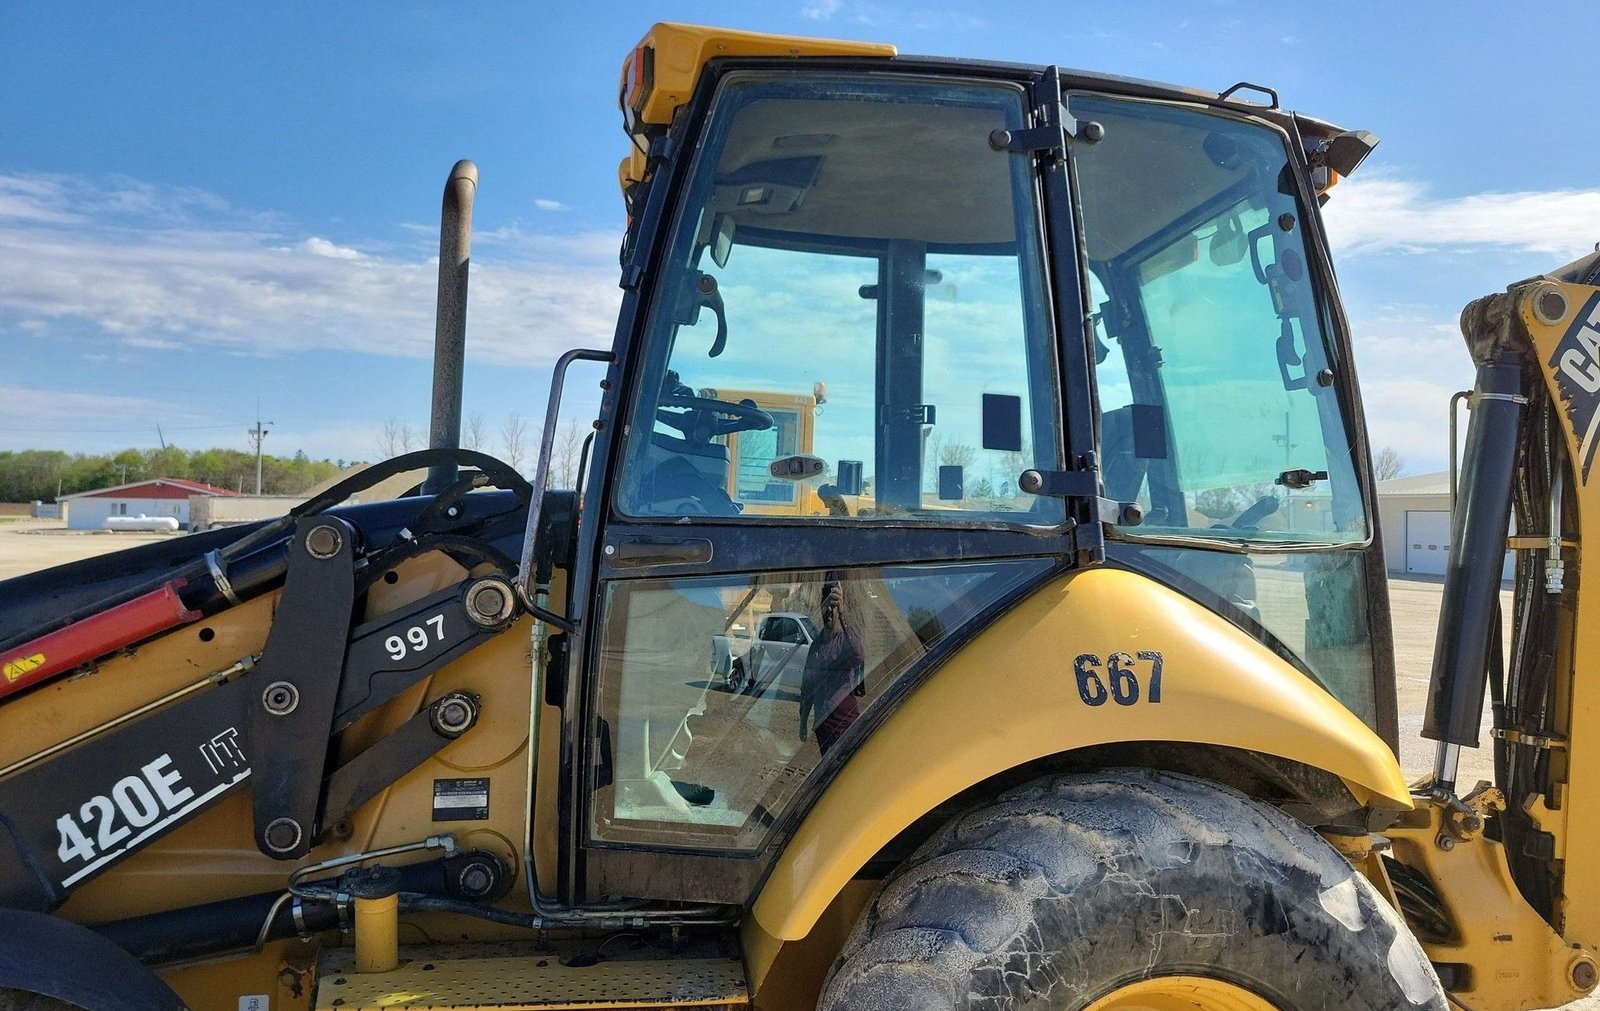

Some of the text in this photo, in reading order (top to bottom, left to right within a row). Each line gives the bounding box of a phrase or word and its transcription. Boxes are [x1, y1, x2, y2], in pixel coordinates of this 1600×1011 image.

[385, 614, 445, 661] 997
[1073, 651, 1163, 706] 667
[56, 753, 195, 863] 420E
